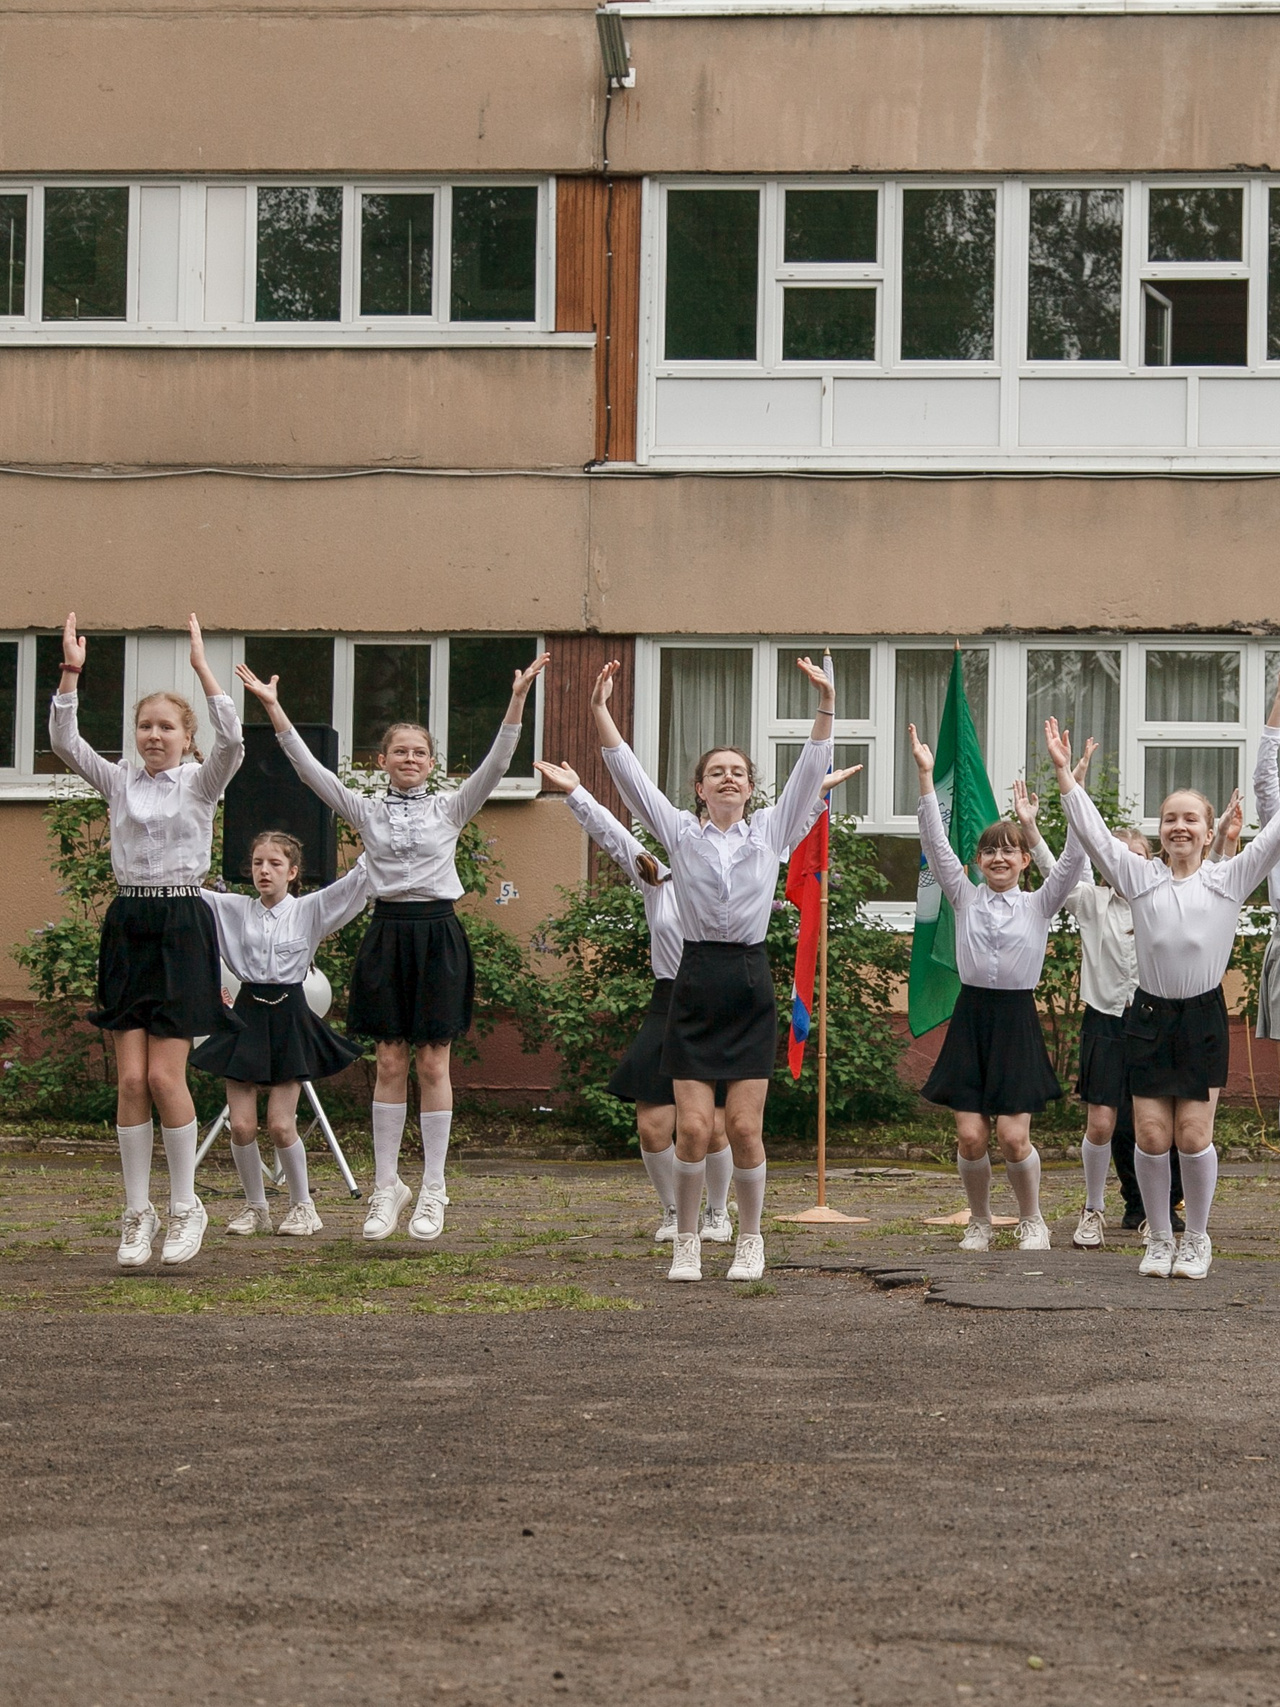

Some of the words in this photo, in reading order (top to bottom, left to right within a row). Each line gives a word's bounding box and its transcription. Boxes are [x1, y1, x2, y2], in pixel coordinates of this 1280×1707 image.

[137, 886, 165, 898] LOVE
[166, 886, 192, 897] LOVE
[501, 884, 511, 897] 5
